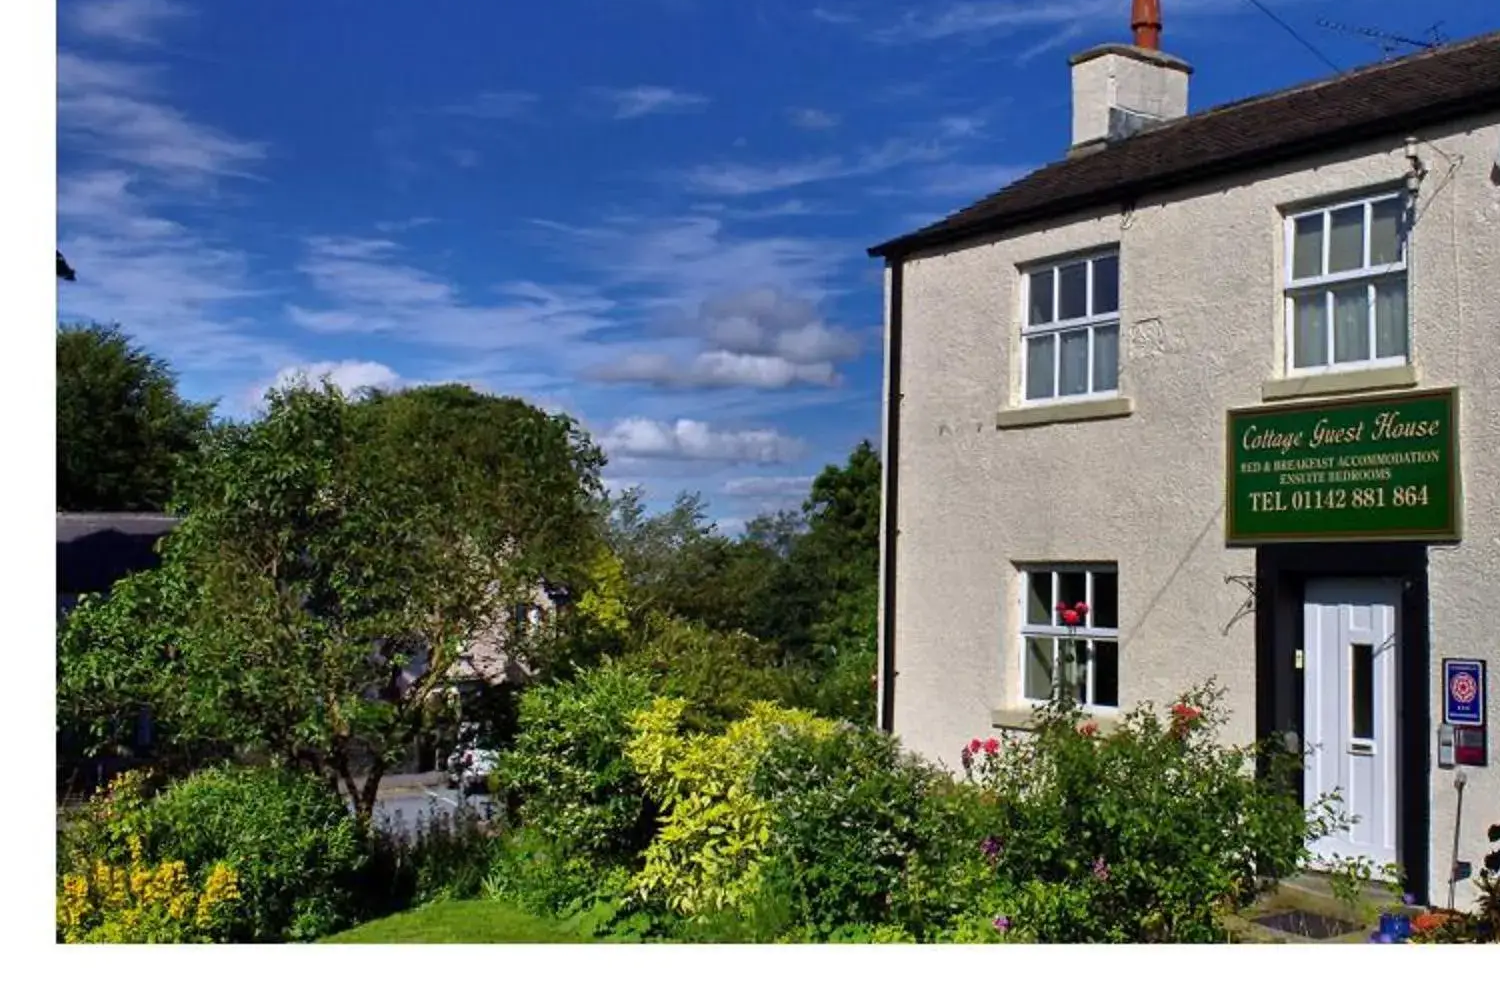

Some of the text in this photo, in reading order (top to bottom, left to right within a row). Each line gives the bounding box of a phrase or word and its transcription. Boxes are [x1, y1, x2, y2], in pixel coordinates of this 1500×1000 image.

[1242, 411, 1440, 454] Cottage Guest House
[1241, 450, 1440, 473] BED & BREAKFAST ACCOMMODATION
[1279, 467, 1392, 486] ENSUITE BEDROOMS
[1249, 484, 1429, 512] TEL 01142 881 864
